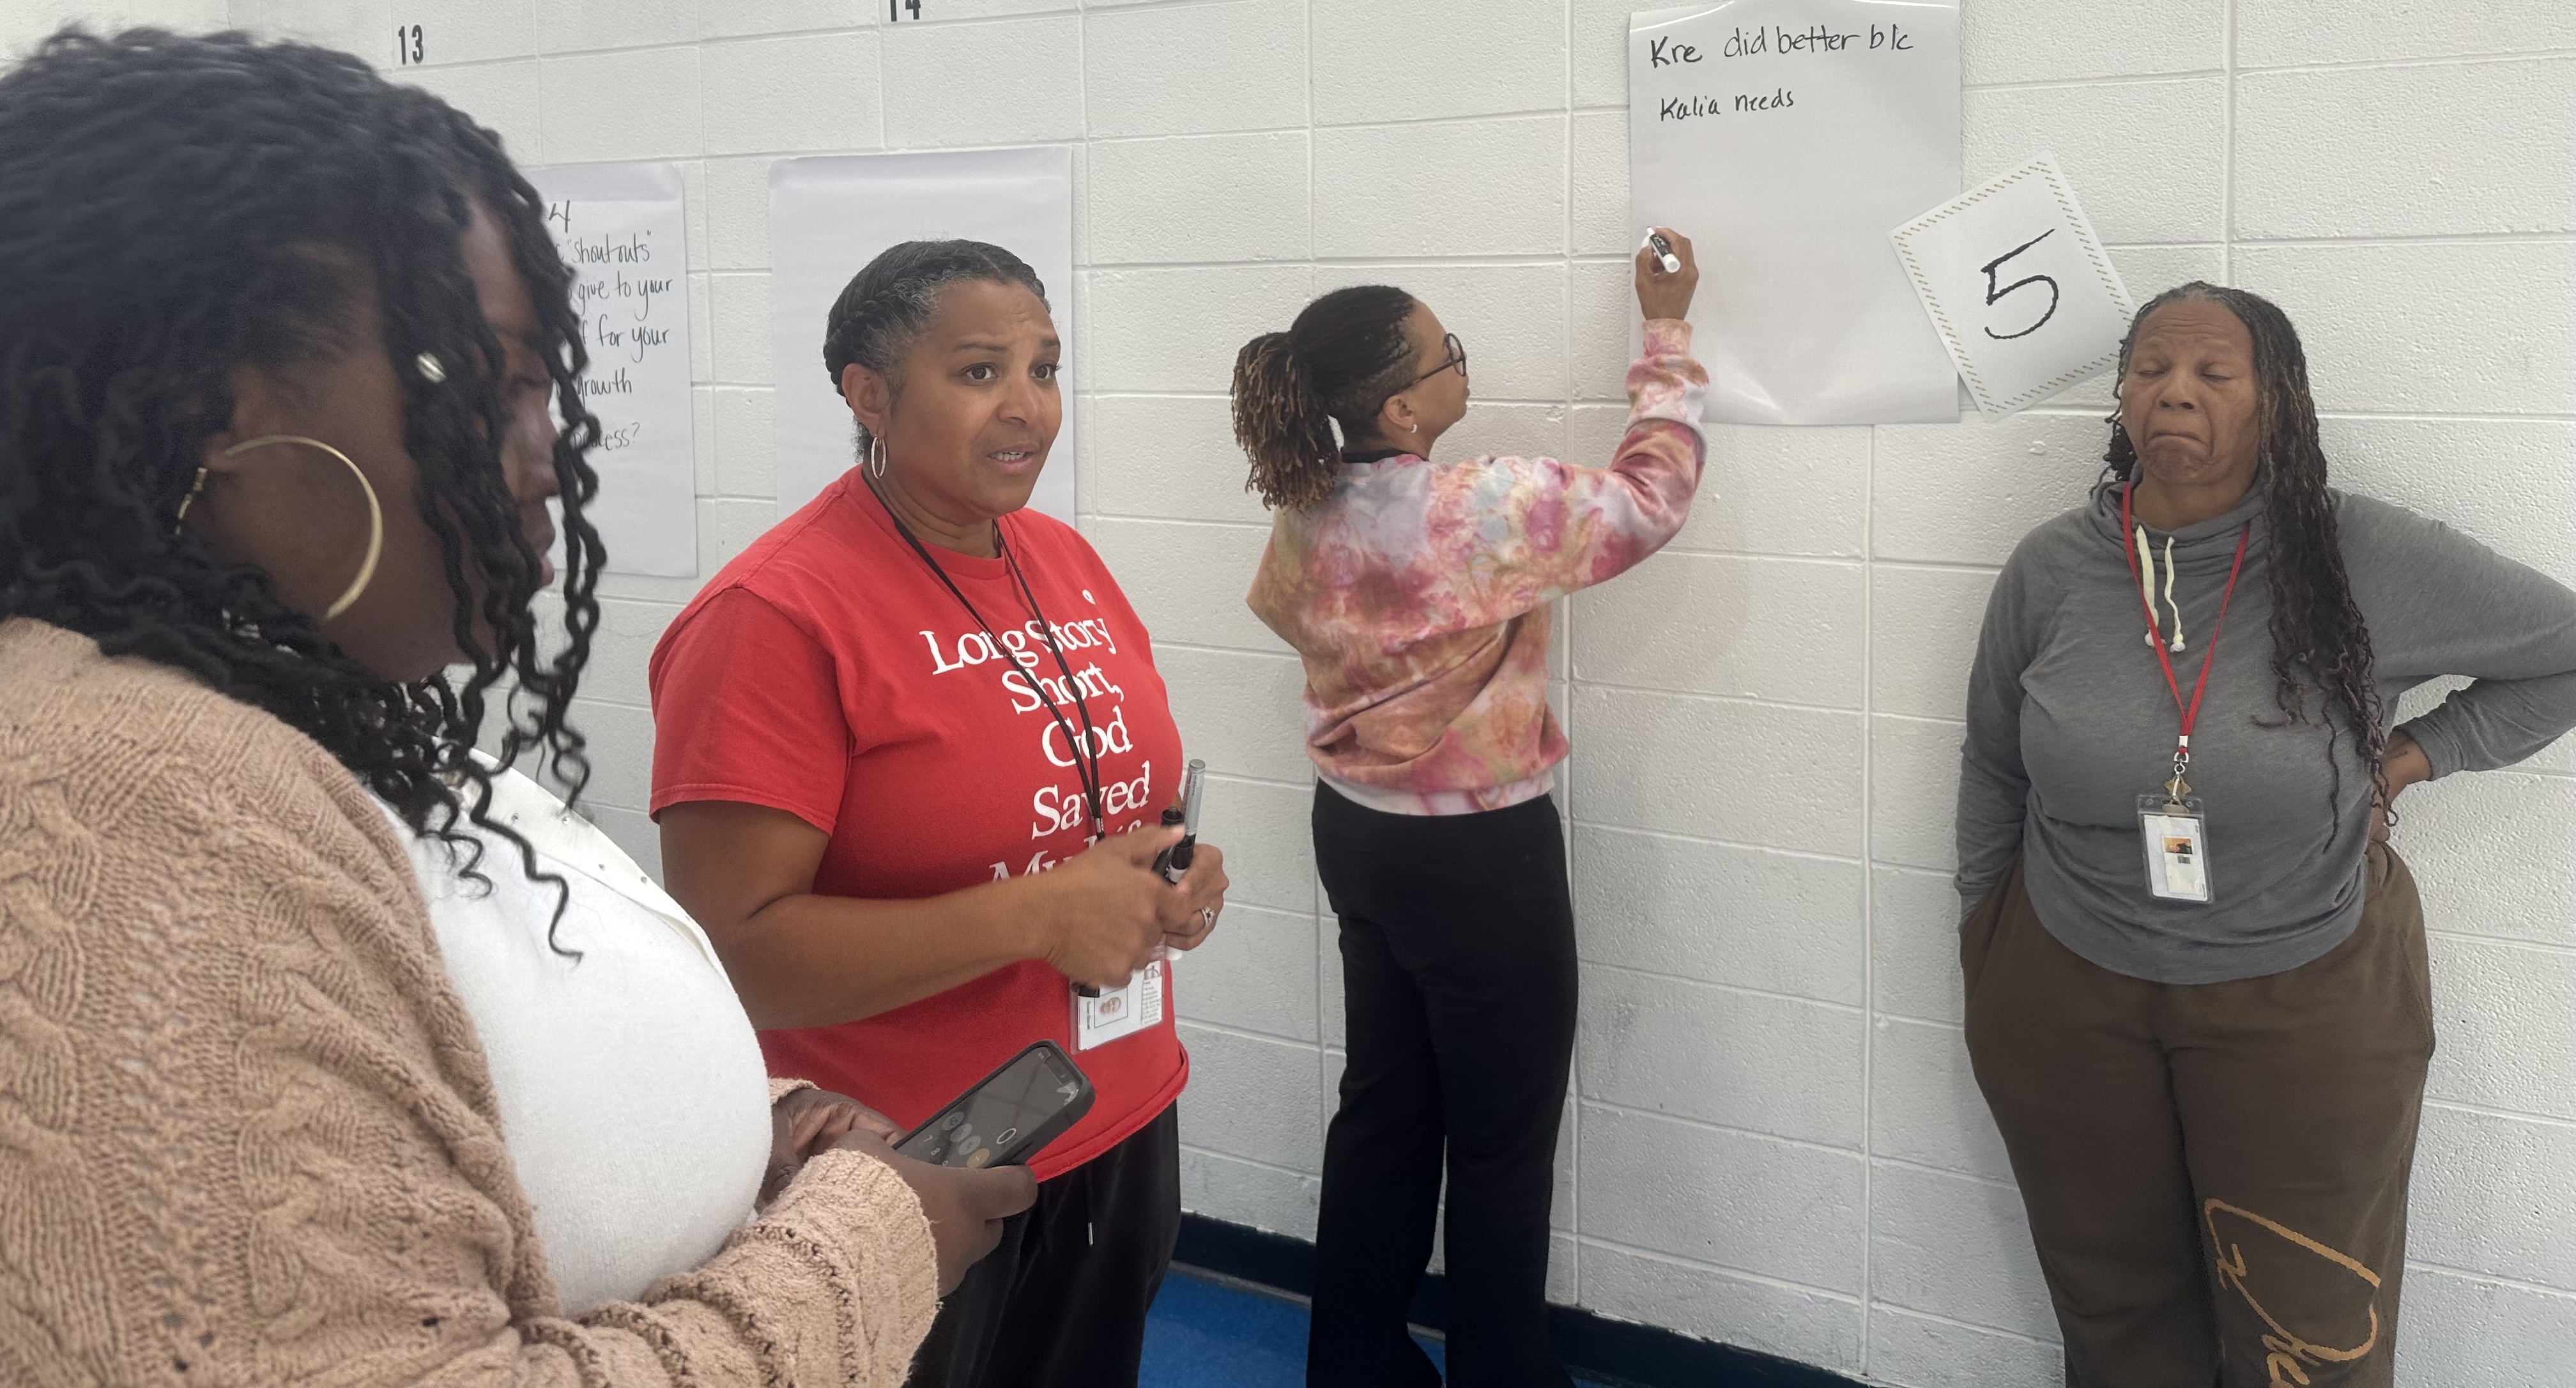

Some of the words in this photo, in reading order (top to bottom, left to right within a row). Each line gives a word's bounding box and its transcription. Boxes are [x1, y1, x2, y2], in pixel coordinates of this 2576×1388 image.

[398, 24, 424, 65] 13
[1650, 36, 1703, 68] Kre
[1724, 26, 1767, 58] did
[1776, 25, 1860, 54] better
[1660, 95, 1721, 121] Kalia
[1735, 88, 1793, 112] needs
[549, 200, 571, 233] 4
[578, 281, 610, 316] give
[617, 271, 631, 298] to
[634, 278, 673, 321] your
[1981, 228, 2059, 339] 5
[598, 313, 623, 347] for
[631, 327, 670, 363] your
[577, 367, 632, 410] growth
[919, 630, 1039, 675] Long
[1025, 618, 1117, 655] Story
[1001, 661, 1124, 714] Short,
[1042, 705, 1133, 767] God
[1032, 760, 1150, 840] Saved
